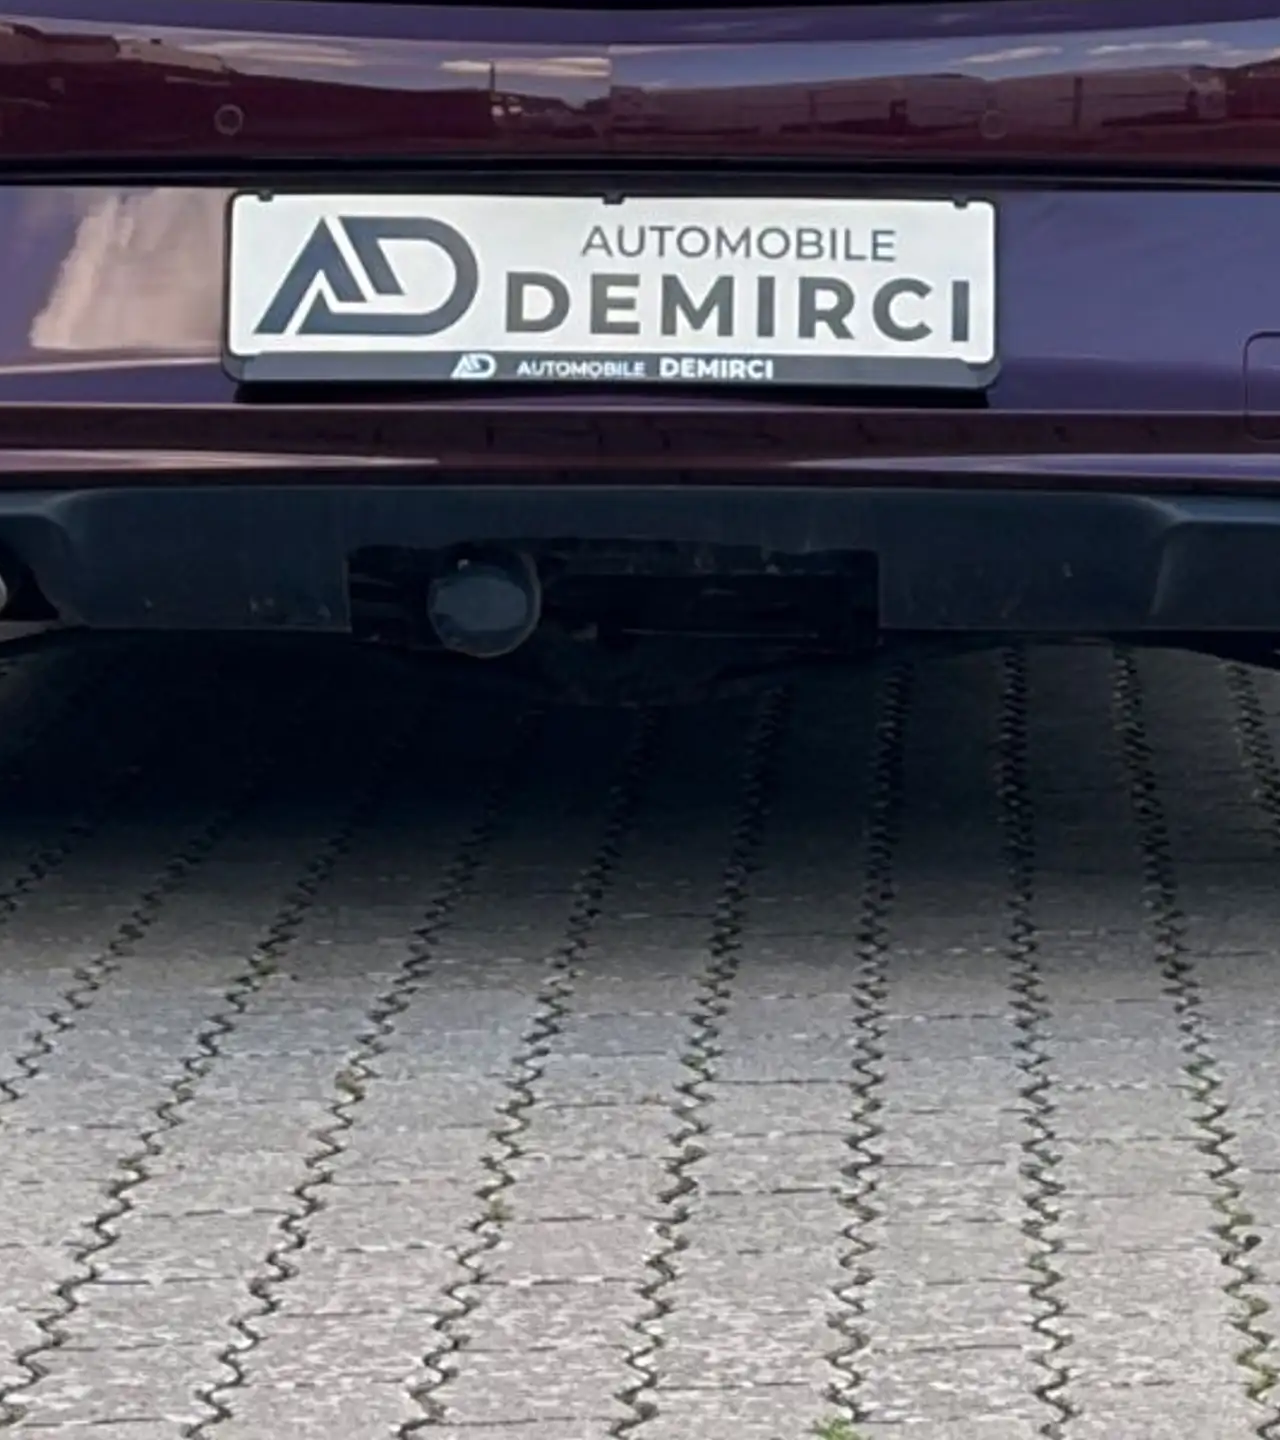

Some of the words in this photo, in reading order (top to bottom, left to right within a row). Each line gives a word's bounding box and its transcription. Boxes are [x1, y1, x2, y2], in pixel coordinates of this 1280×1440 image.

[581, 224, 897, 262] AUTOMOBILE
[505, 270, 971, 342] DEMIRCI
[517, 359, 647, 379] AUTOMOBILE
[659, 357, 774, 380] DEMIRCI
